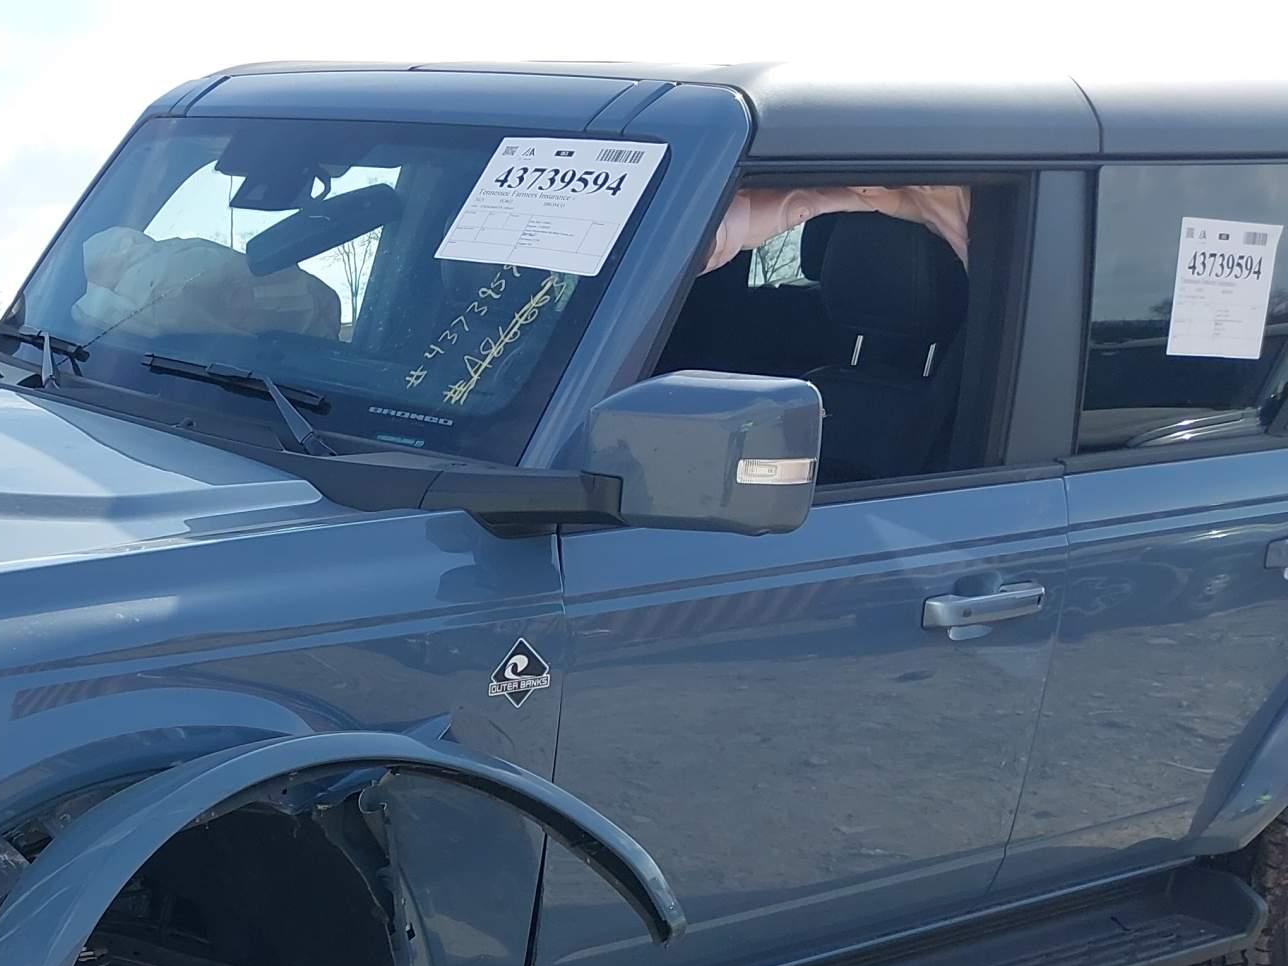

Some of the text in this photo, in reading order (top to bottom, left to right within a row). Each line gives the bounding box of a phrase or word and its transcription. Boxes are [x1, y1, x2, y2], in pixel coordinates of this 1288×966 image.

[494, 166, 628, 196] 43739594
[511, 190, 538, 199] Farmers
[539, 192, 571, 201] Insurance
[1188, 251, 1263, 280] 43739594
[368, 406, 454, 426] BRONCO
[491, 678, 548, 693] OUTER BANKS
